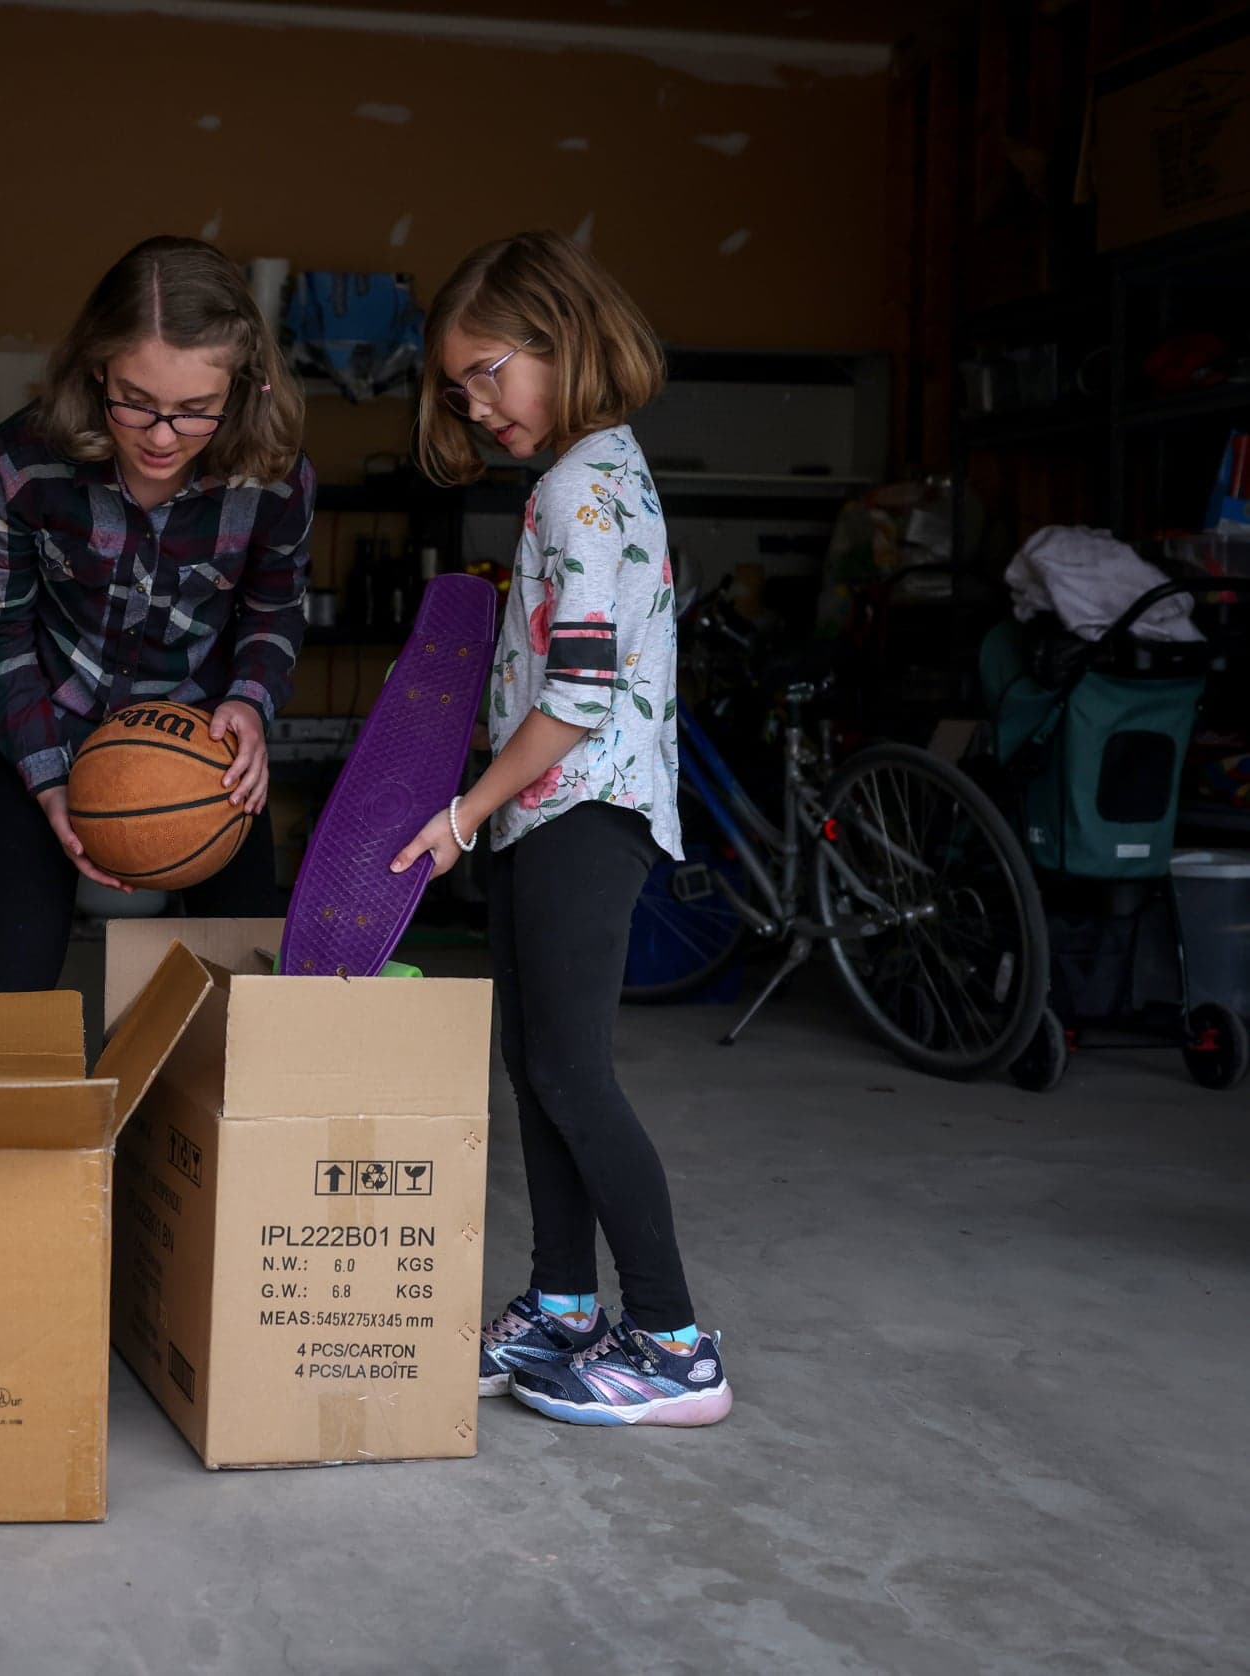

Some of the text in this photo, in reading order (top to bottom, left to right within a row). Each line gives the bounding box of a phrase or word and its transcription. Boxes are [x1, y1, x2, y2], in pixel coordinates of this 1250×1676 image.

[101, 708, 195, 742] Wils
[260, 1225, 436, 1248] IPL222B01 BN
[262, 1256, 435, 1273] N.W.: 6.0 KGS
[261, 1283, 434, 1299] G.W.: 6.8 KGS
[405, 1315, 434, 1328] mm
[296, 1342, 416, 1359] 4 PCS/CARTON
[294, 1360, 419, 1380] 4 PCS/LA BOÎTE
